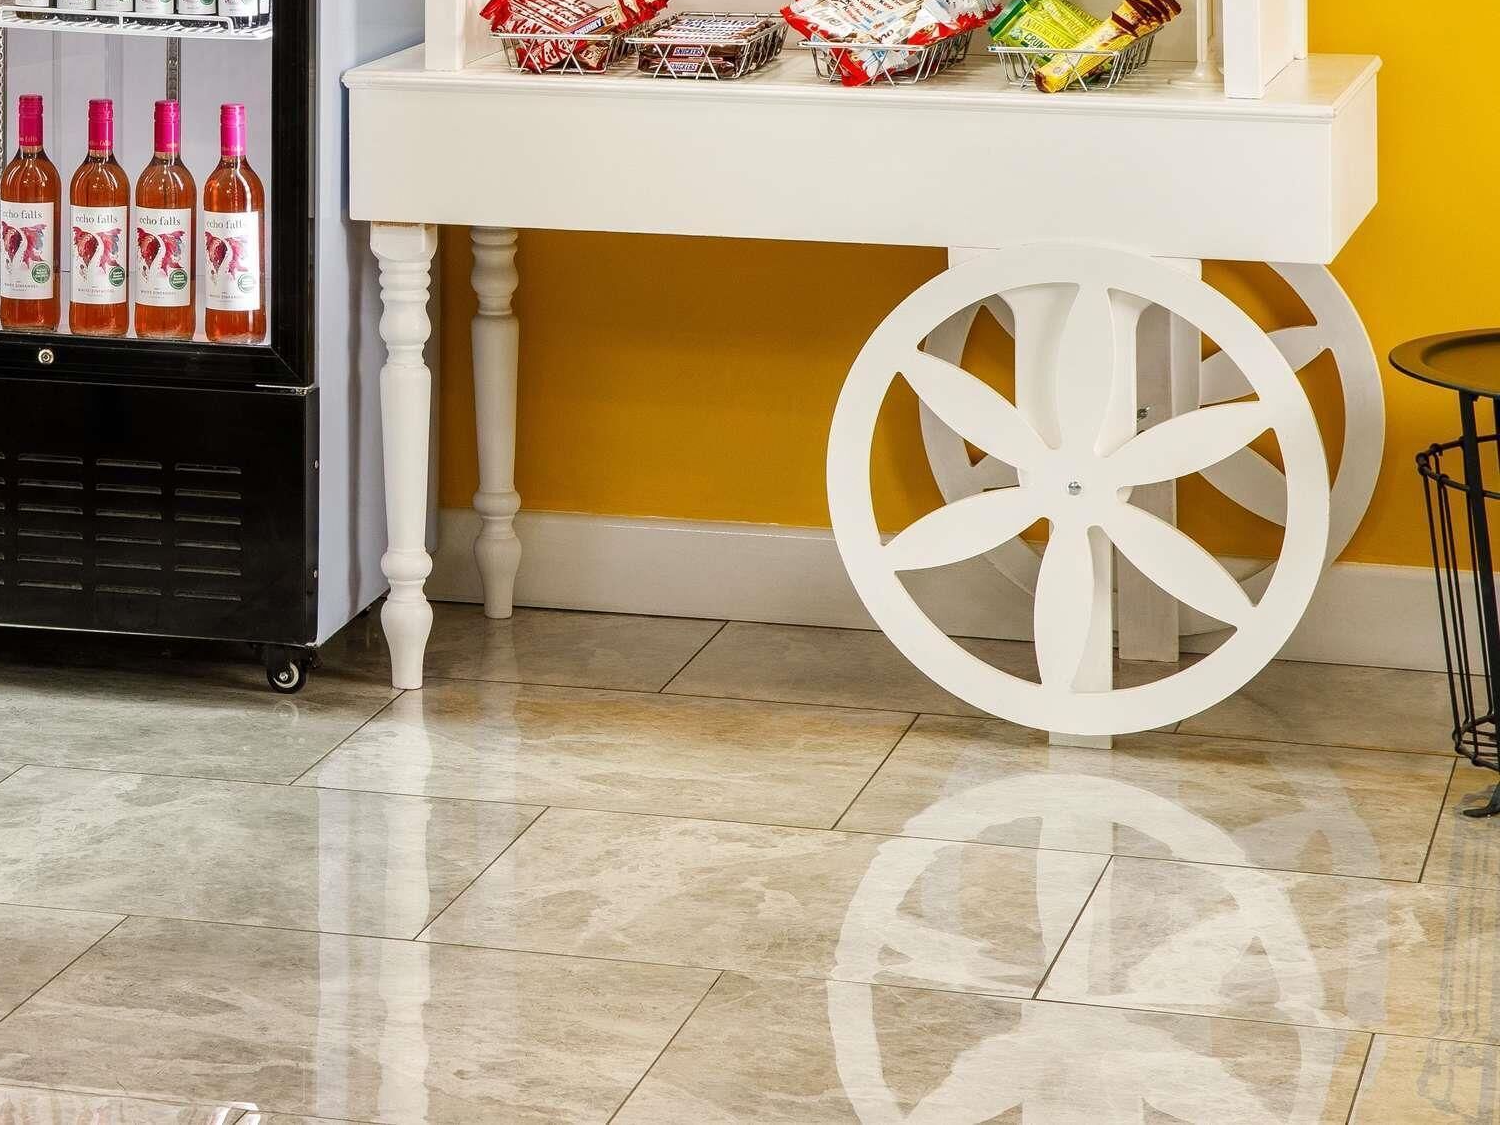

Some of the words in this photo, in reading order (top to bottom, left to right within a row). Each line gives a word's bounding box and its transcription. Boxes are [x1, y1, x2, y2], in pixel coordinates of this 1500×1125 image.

[675, 47, 702, 55] SNICKERS
[2, 209, 19, 219] echo
[21, 210, 44, 219] falls
[75, 213, 95, 224] echo
[97, 214, 118, 224] falls
[139, 216, 158, 225] echo
[160, 216, 181, 225] falls
[206, 219, 224, 228] echo
